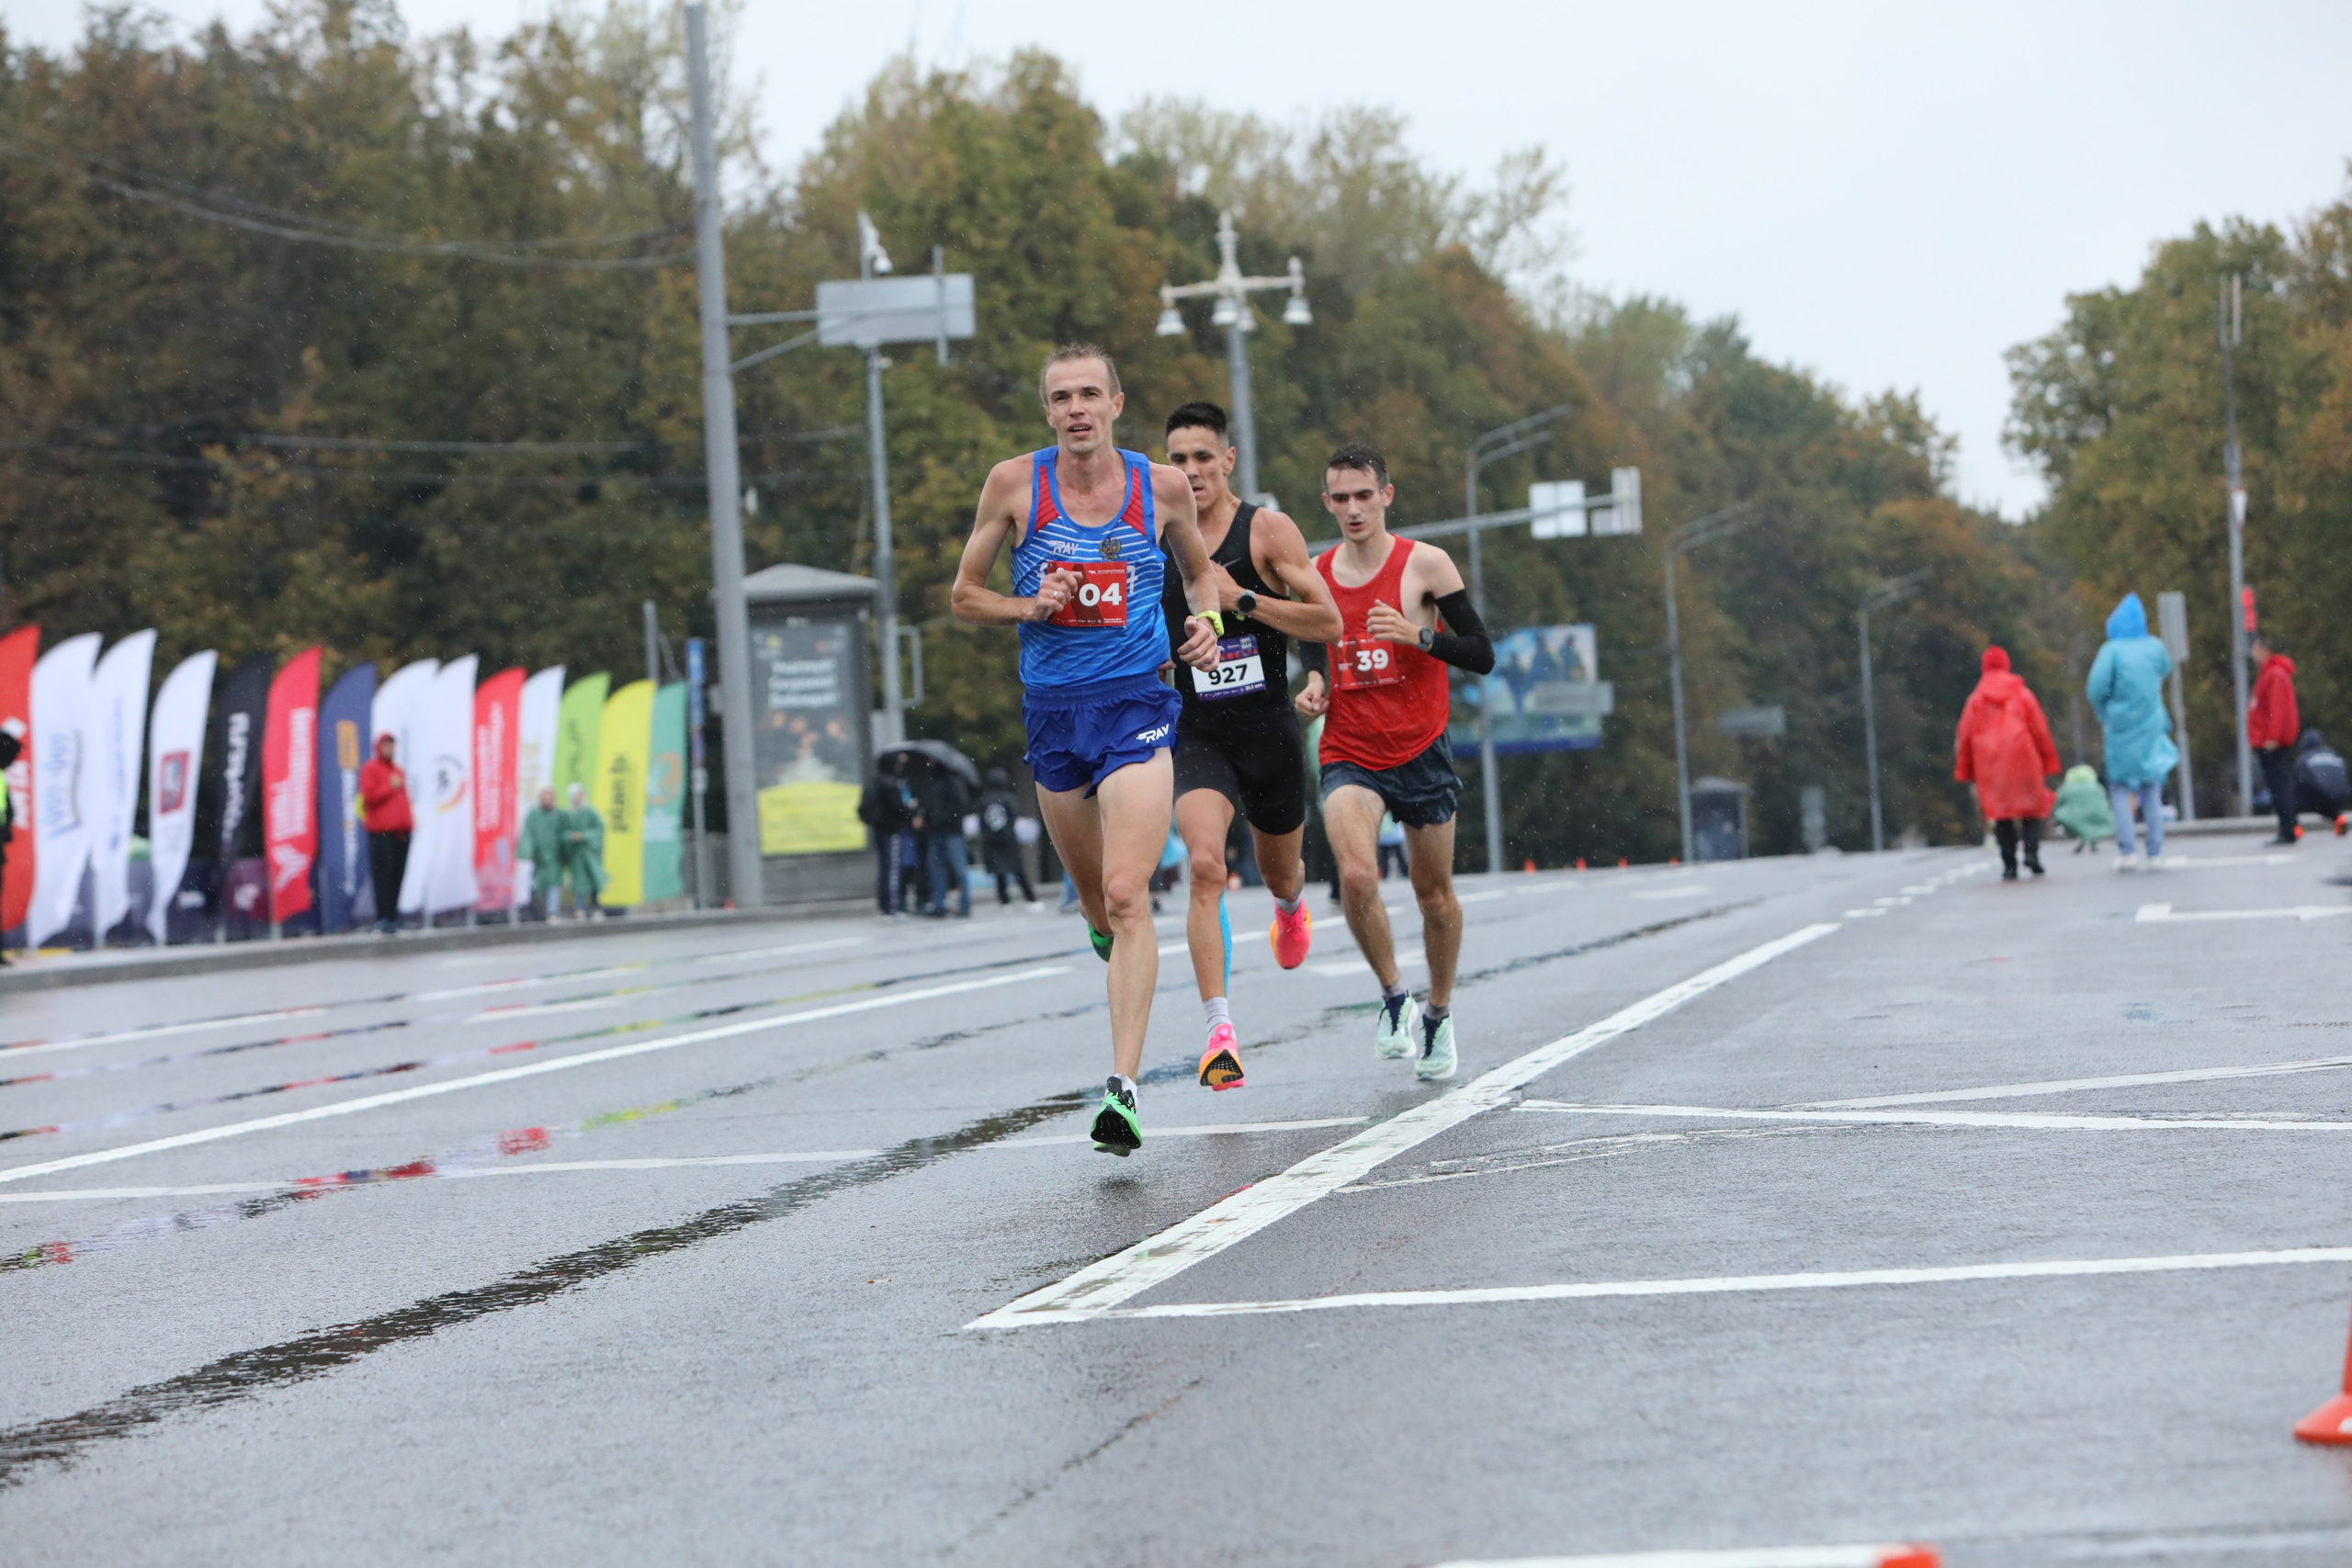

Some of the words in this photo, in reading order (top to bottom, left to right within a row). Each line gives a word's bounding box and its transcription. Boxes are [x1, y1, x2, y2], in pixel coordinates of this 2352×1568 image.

[1079, 582, 1122, 606] 04
[1356, 649, 1389, 671] 39
[1208, 664, 1248, 685] 927
